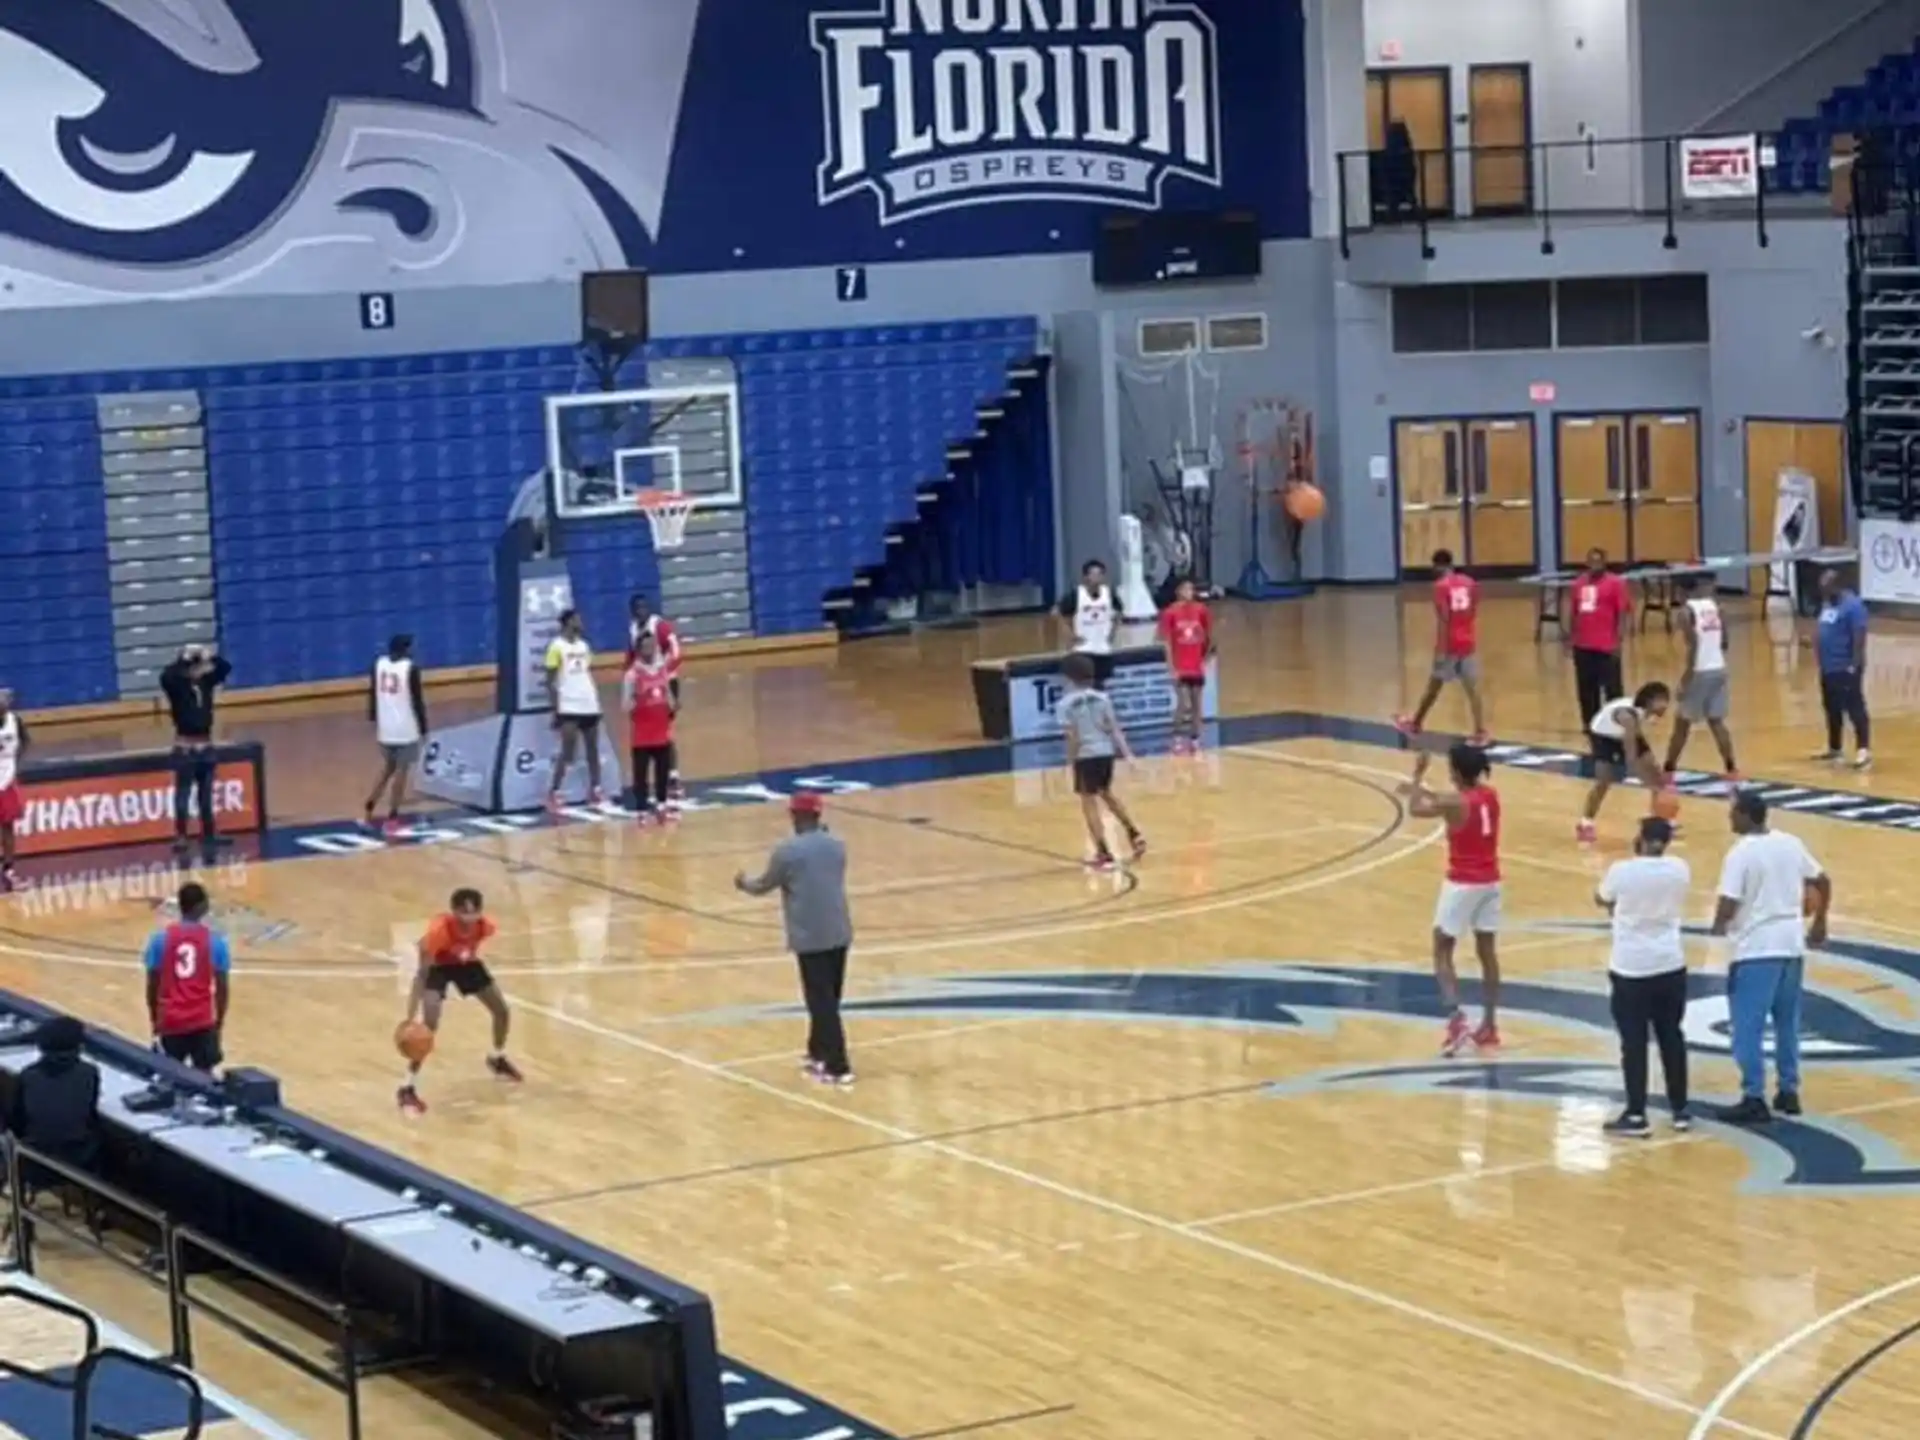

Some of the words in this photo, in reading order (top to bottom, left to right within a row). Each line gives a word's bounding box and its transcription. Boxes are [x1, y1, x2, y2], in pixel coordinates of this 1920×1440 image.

[825, 19, 1209, 182] FLORIDA
[914, 155, 1128, 191] OSPREYS
[844, 269, 857, 298] 7
[369, 296, 386, 327] 8
[1481, 803, 1491, 836] 1
[174, 942, 197, 979] 3
